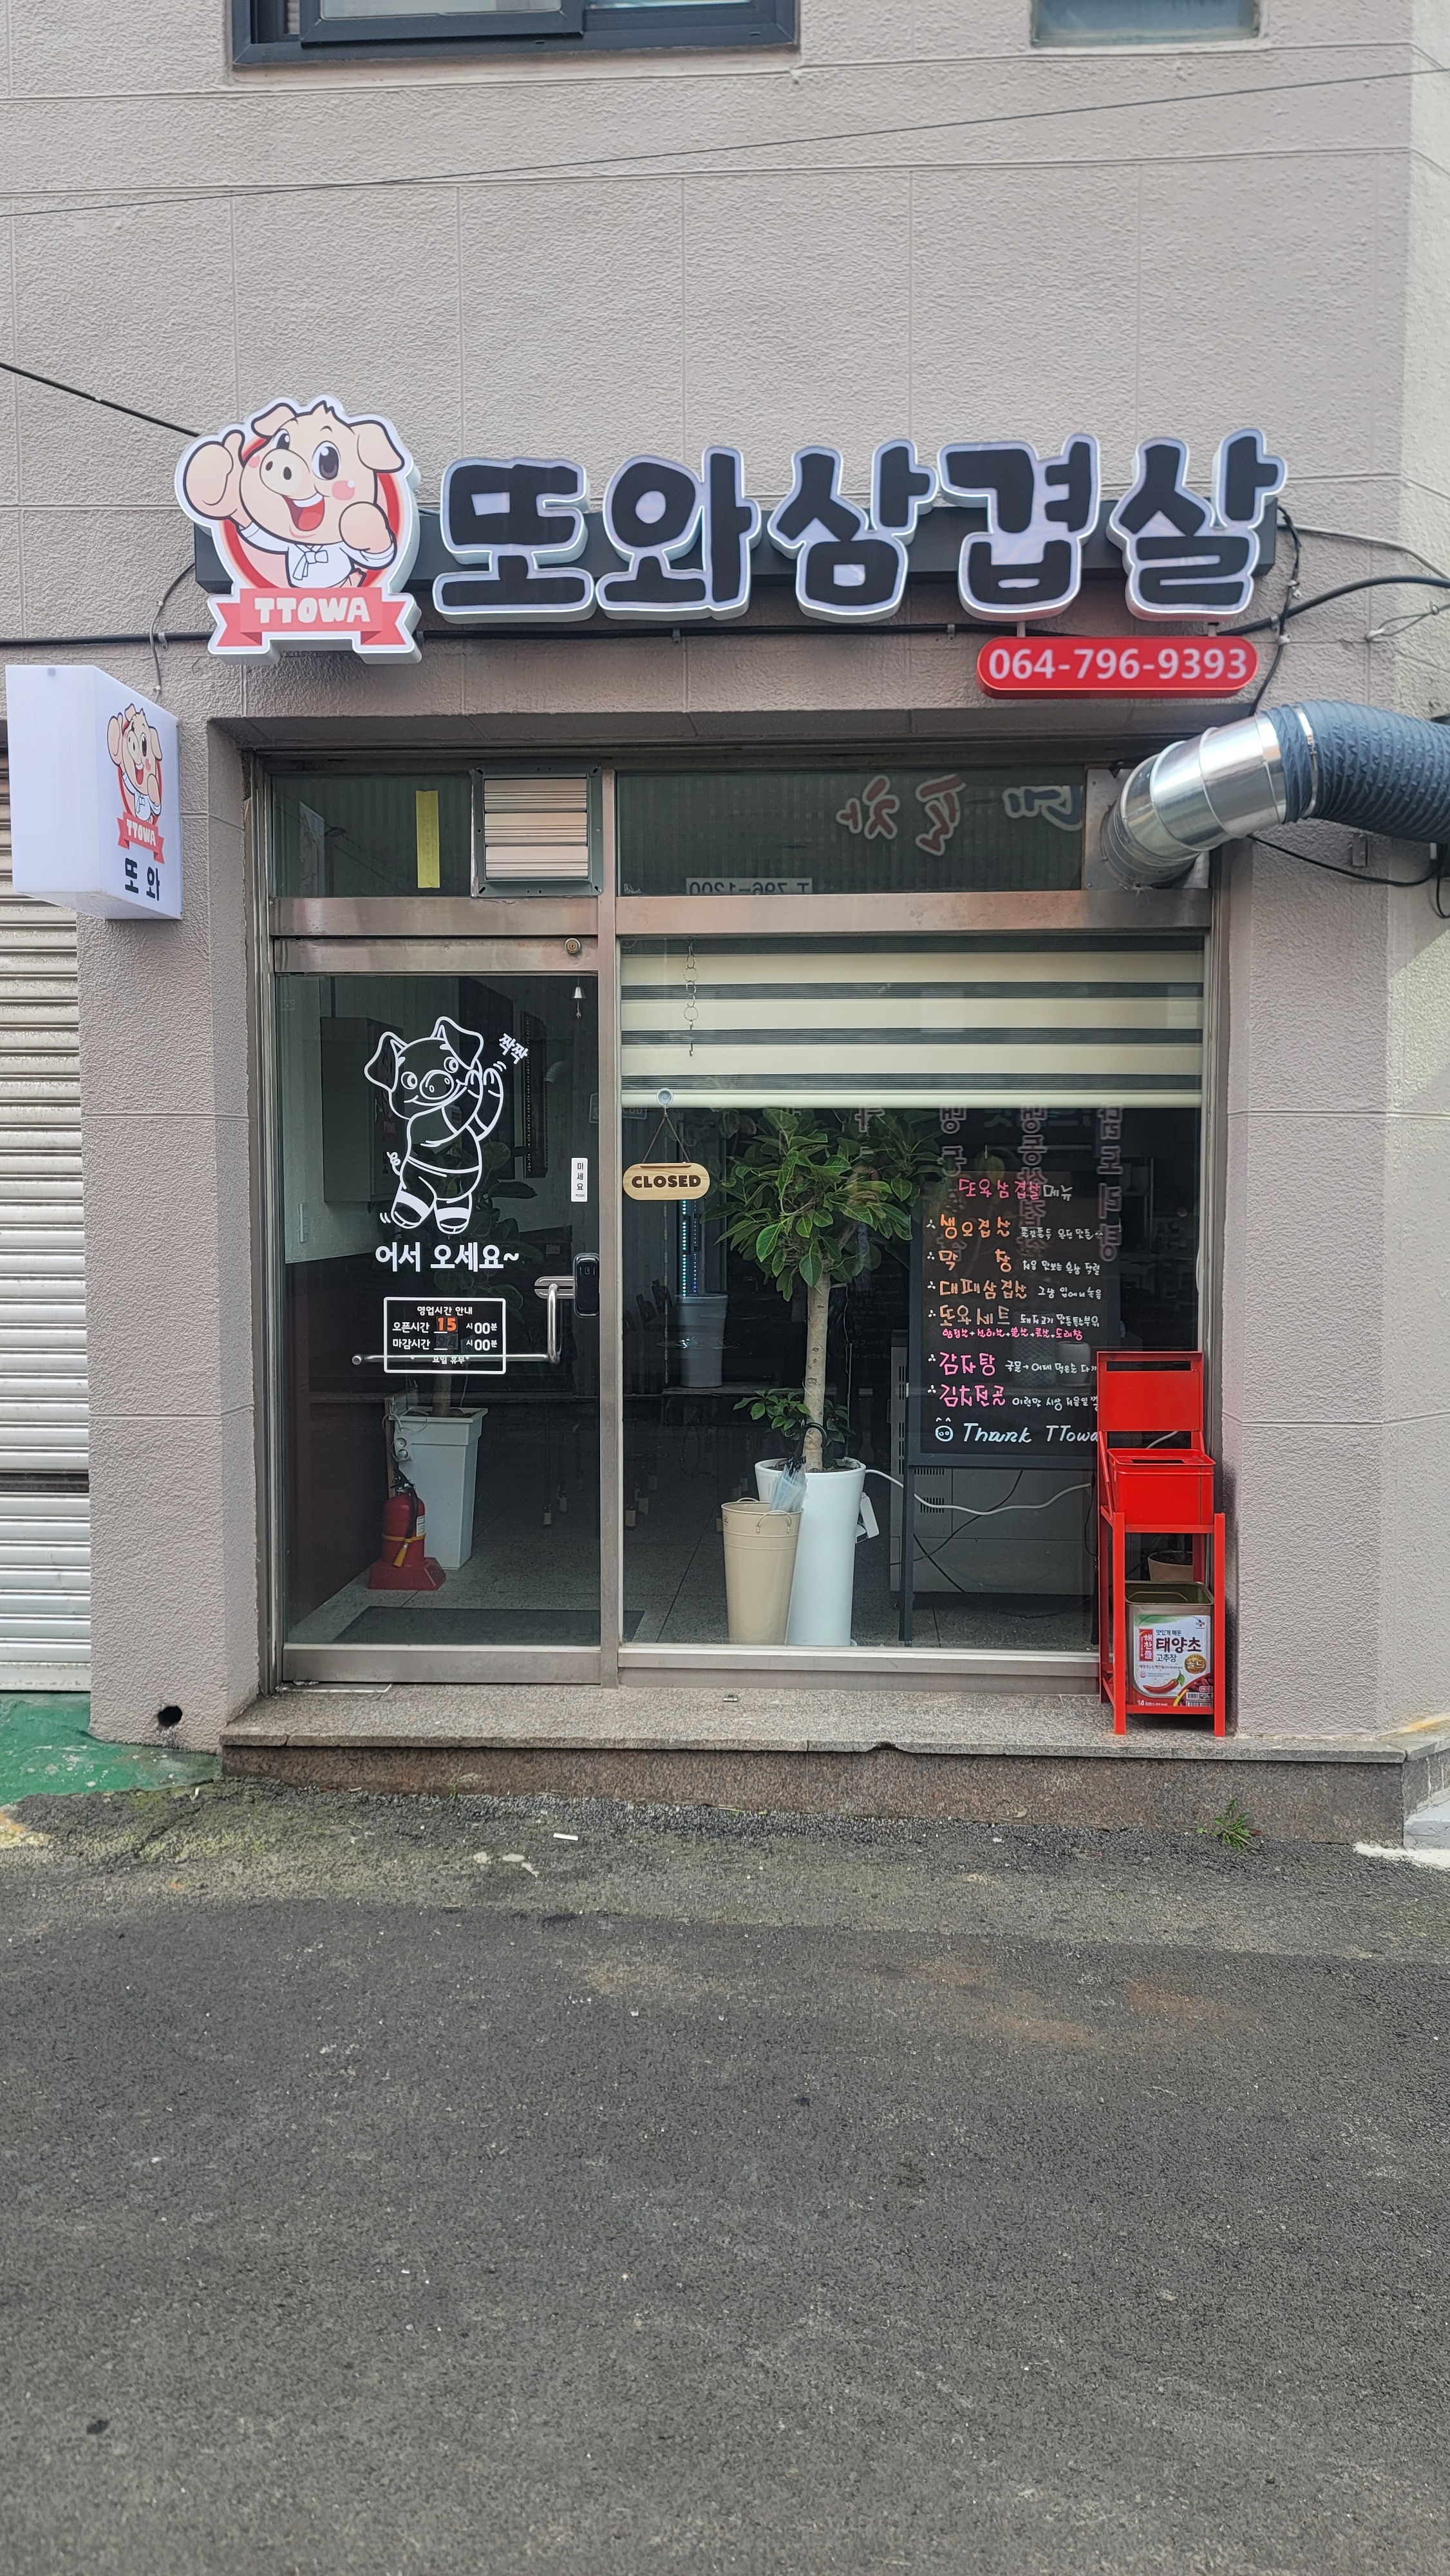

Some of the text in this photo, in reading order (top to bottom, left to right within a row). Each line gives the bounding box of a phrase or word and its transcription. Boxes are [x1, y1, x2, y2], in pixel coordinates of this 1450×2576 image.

[438, 433, 1281, 609] 또와삼겹살
[253, 596, 370, 624] TTOWA
[988, 648, 1247, 680] 064-796-9393
[126, 820, 156, 847] TTOWA
[498, 1033, 529, 1064] 짝짝
[632, 1175, 701, 1188] CLOSED
[1043, 1184, 1073, 1201] 메뉴
[1058, 1229, 1073, 1239] 완전
[375, 1242, 519, 1273] 어서 오세요~
[1041, 1260, 1062, 1271] 맛보는
[1066, 1261, 1080, 1275] 환상
[939, 1278, 1027, 1300] 대패삼겹살
[1038, 1285, 1055, 1298] 그냥
[417, 1306, 473, 1316] 영업시간 안내
[1020, 1314, 1053, 1325] 돼지고기
[392, 1322, 429, 1333] 오픈시간
[437, 1318, 458, 1332] 15
[392, 1339, 430, 1350] 마감시간
[939, 1352, 995, 1376] 감자탕
[1031, 1363, 1052, 1371] 어제
[939, 1384, 1005, 1408] 김치전골
[964, 1423, 1031, 1443] Thank
[1156, 1636, 1202, 1654] 태양초
[1156, 1653, 1177, 1663] 고추장
[1186, 1658, 1205, 1669] 골드
